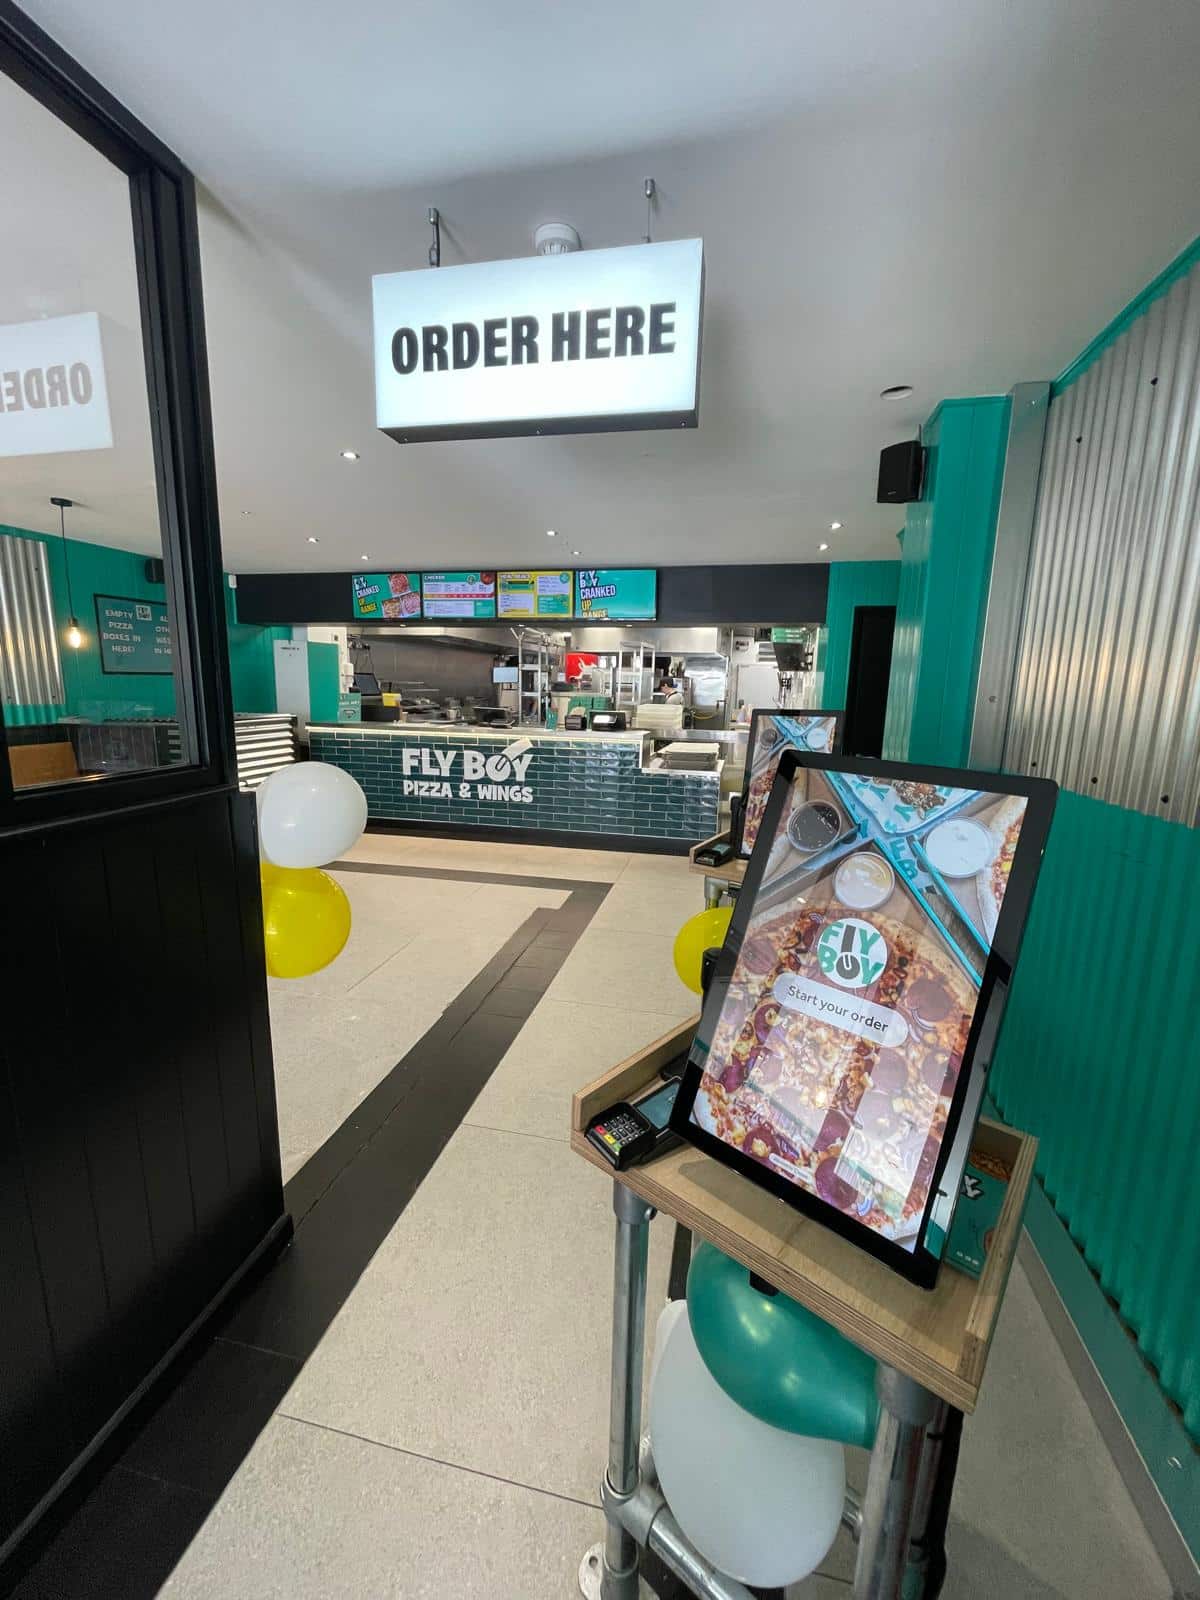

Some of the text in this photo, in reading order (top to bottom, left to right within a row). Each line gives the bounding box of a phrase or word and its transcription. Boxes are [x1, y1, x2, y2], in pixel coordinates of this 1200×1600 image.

[391, 301, 677, 375] ORDER HERE
[580, 585, 616, 600] CRANKED
[104, 609, 133, 618] EMPTY
[108, 621, 133, 630] PIZZA
[103, 632, 141, 643] BOXES IN
[156, 636, 171, 645] WAS
[402, 742, 534, 782] FLY BOY
[403, 779, 534, 803] PIZZA & WINGS
[821, 921, 881, 955] FLY
[818, 944, 885, 985] BOY
[788, 985, 889, 1032] Start your order
